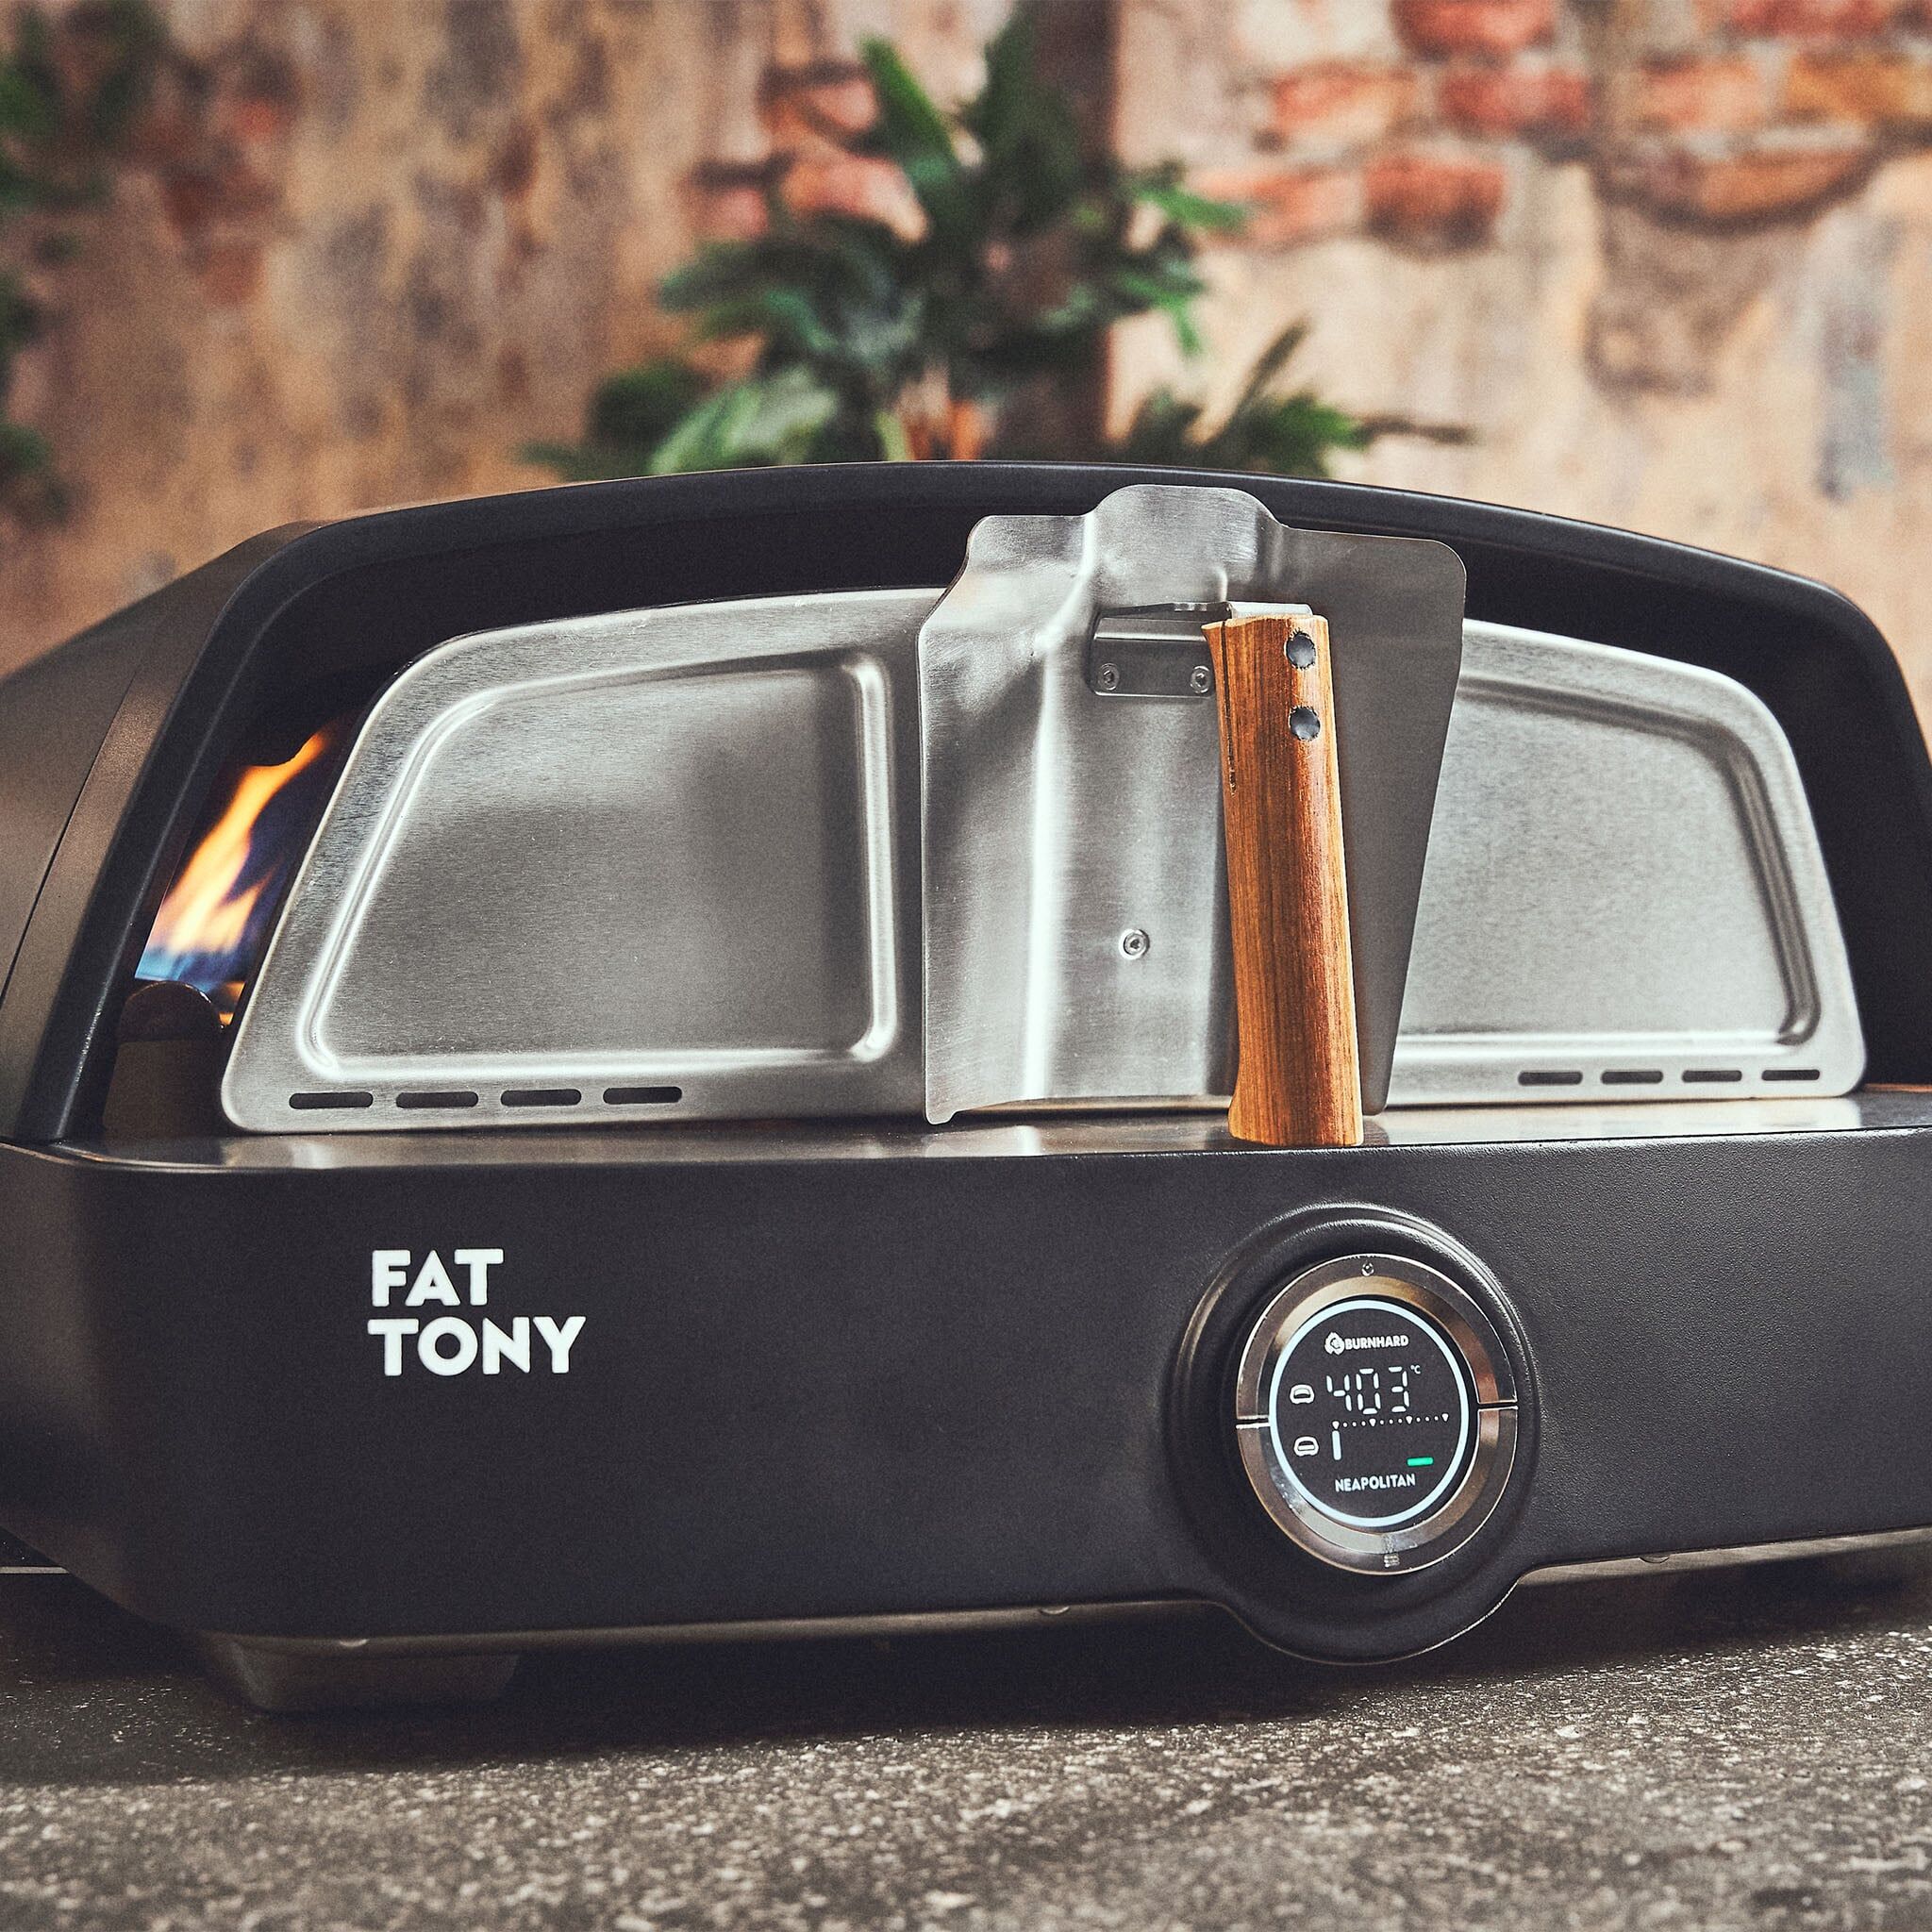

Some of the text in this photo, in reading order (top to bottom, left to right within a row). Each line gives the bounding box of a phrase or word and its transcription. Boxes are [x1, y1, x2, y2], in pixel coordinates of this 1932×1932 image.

[372, 1248, 504, 1307] FAT
[367, 1316, 586, 1376] TONY
[1344, 1335, 1409, 1350] BURNHARD
[1335, 1473, 1415, 1491] NEAPOLITAN
